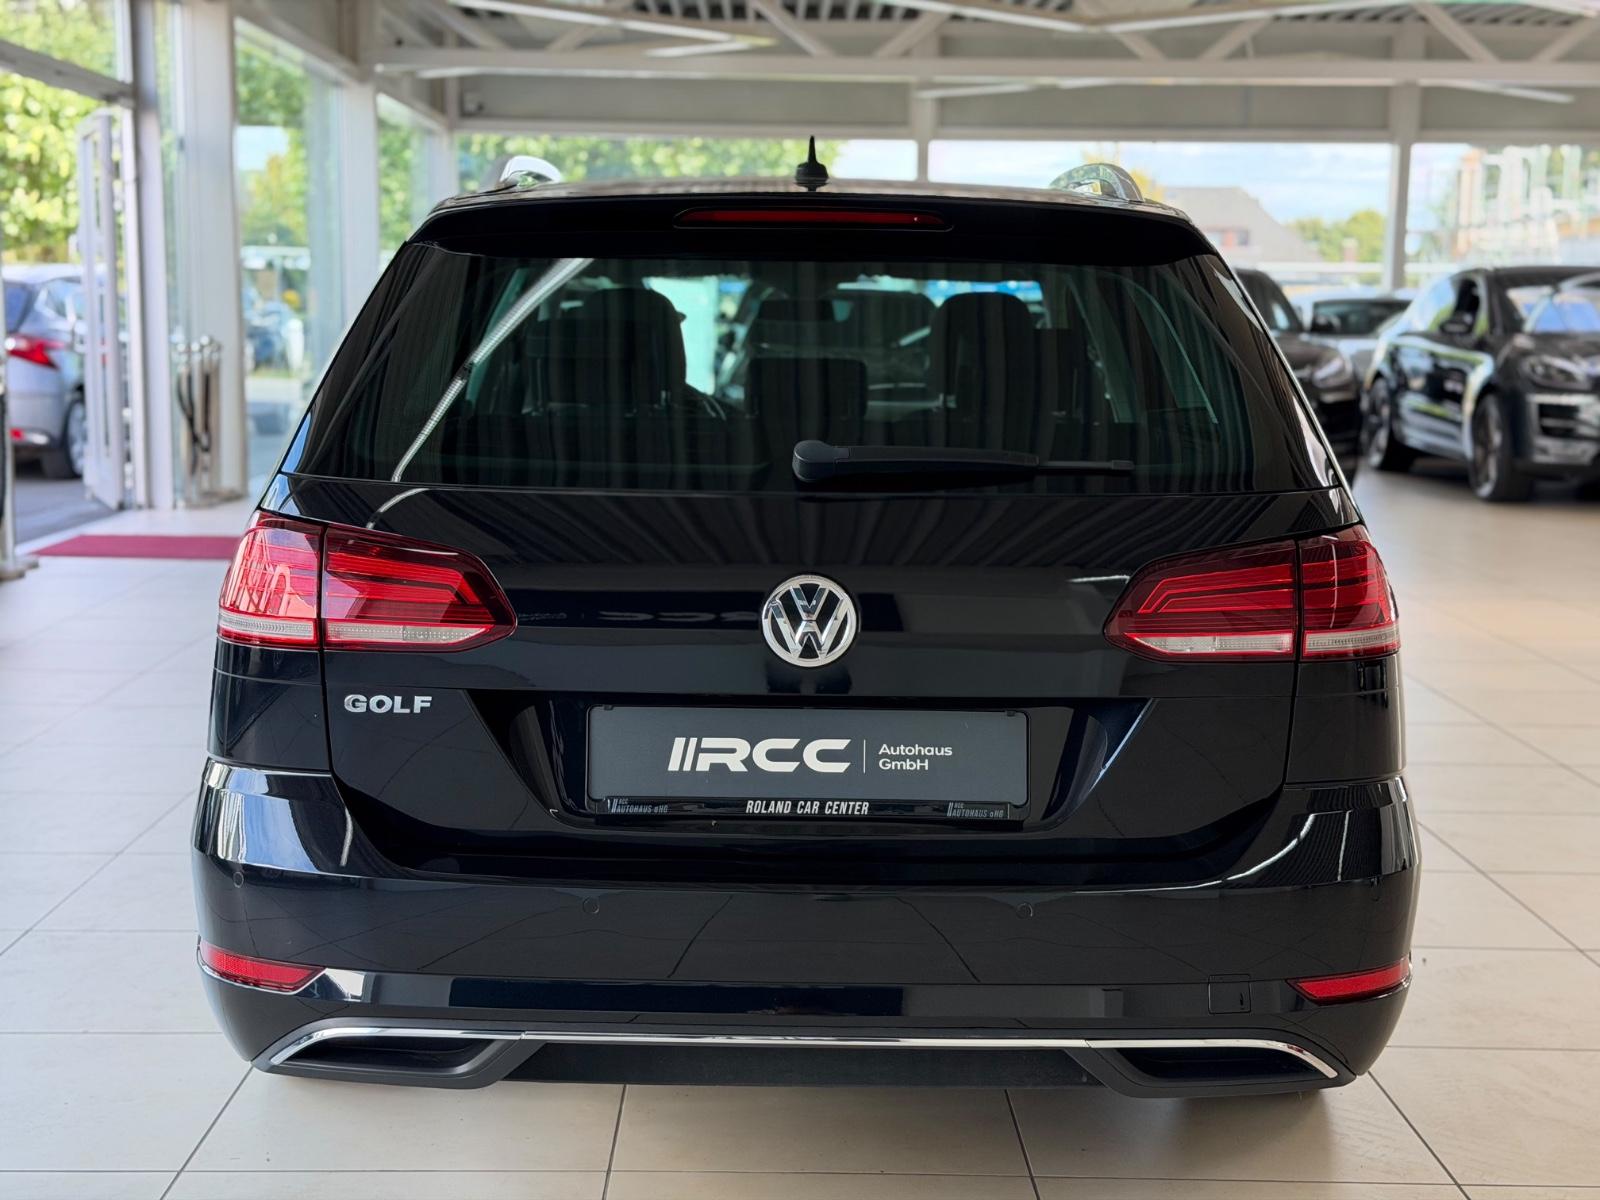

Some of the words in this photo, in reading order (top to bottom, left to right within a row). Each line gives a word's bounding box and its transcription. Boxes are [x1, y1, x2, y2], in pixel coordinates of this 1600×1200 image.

[762, 575, 857, 668] VW
[344, 694, 432, 713] GOLF
[692, 737, 851, 773] RCC
[878, 743, 953, 756] Autohaus
[878, 758, 929, 771] GmbH
[616, 805, 653, 813] AUTOHAUS
[746, 800, 791, 814] ROLAND
[797, 801, 819, 815] CAR
[825, 801, 869, 815] CENTER
[951, 809, 988, 817] AUTOHAUS
